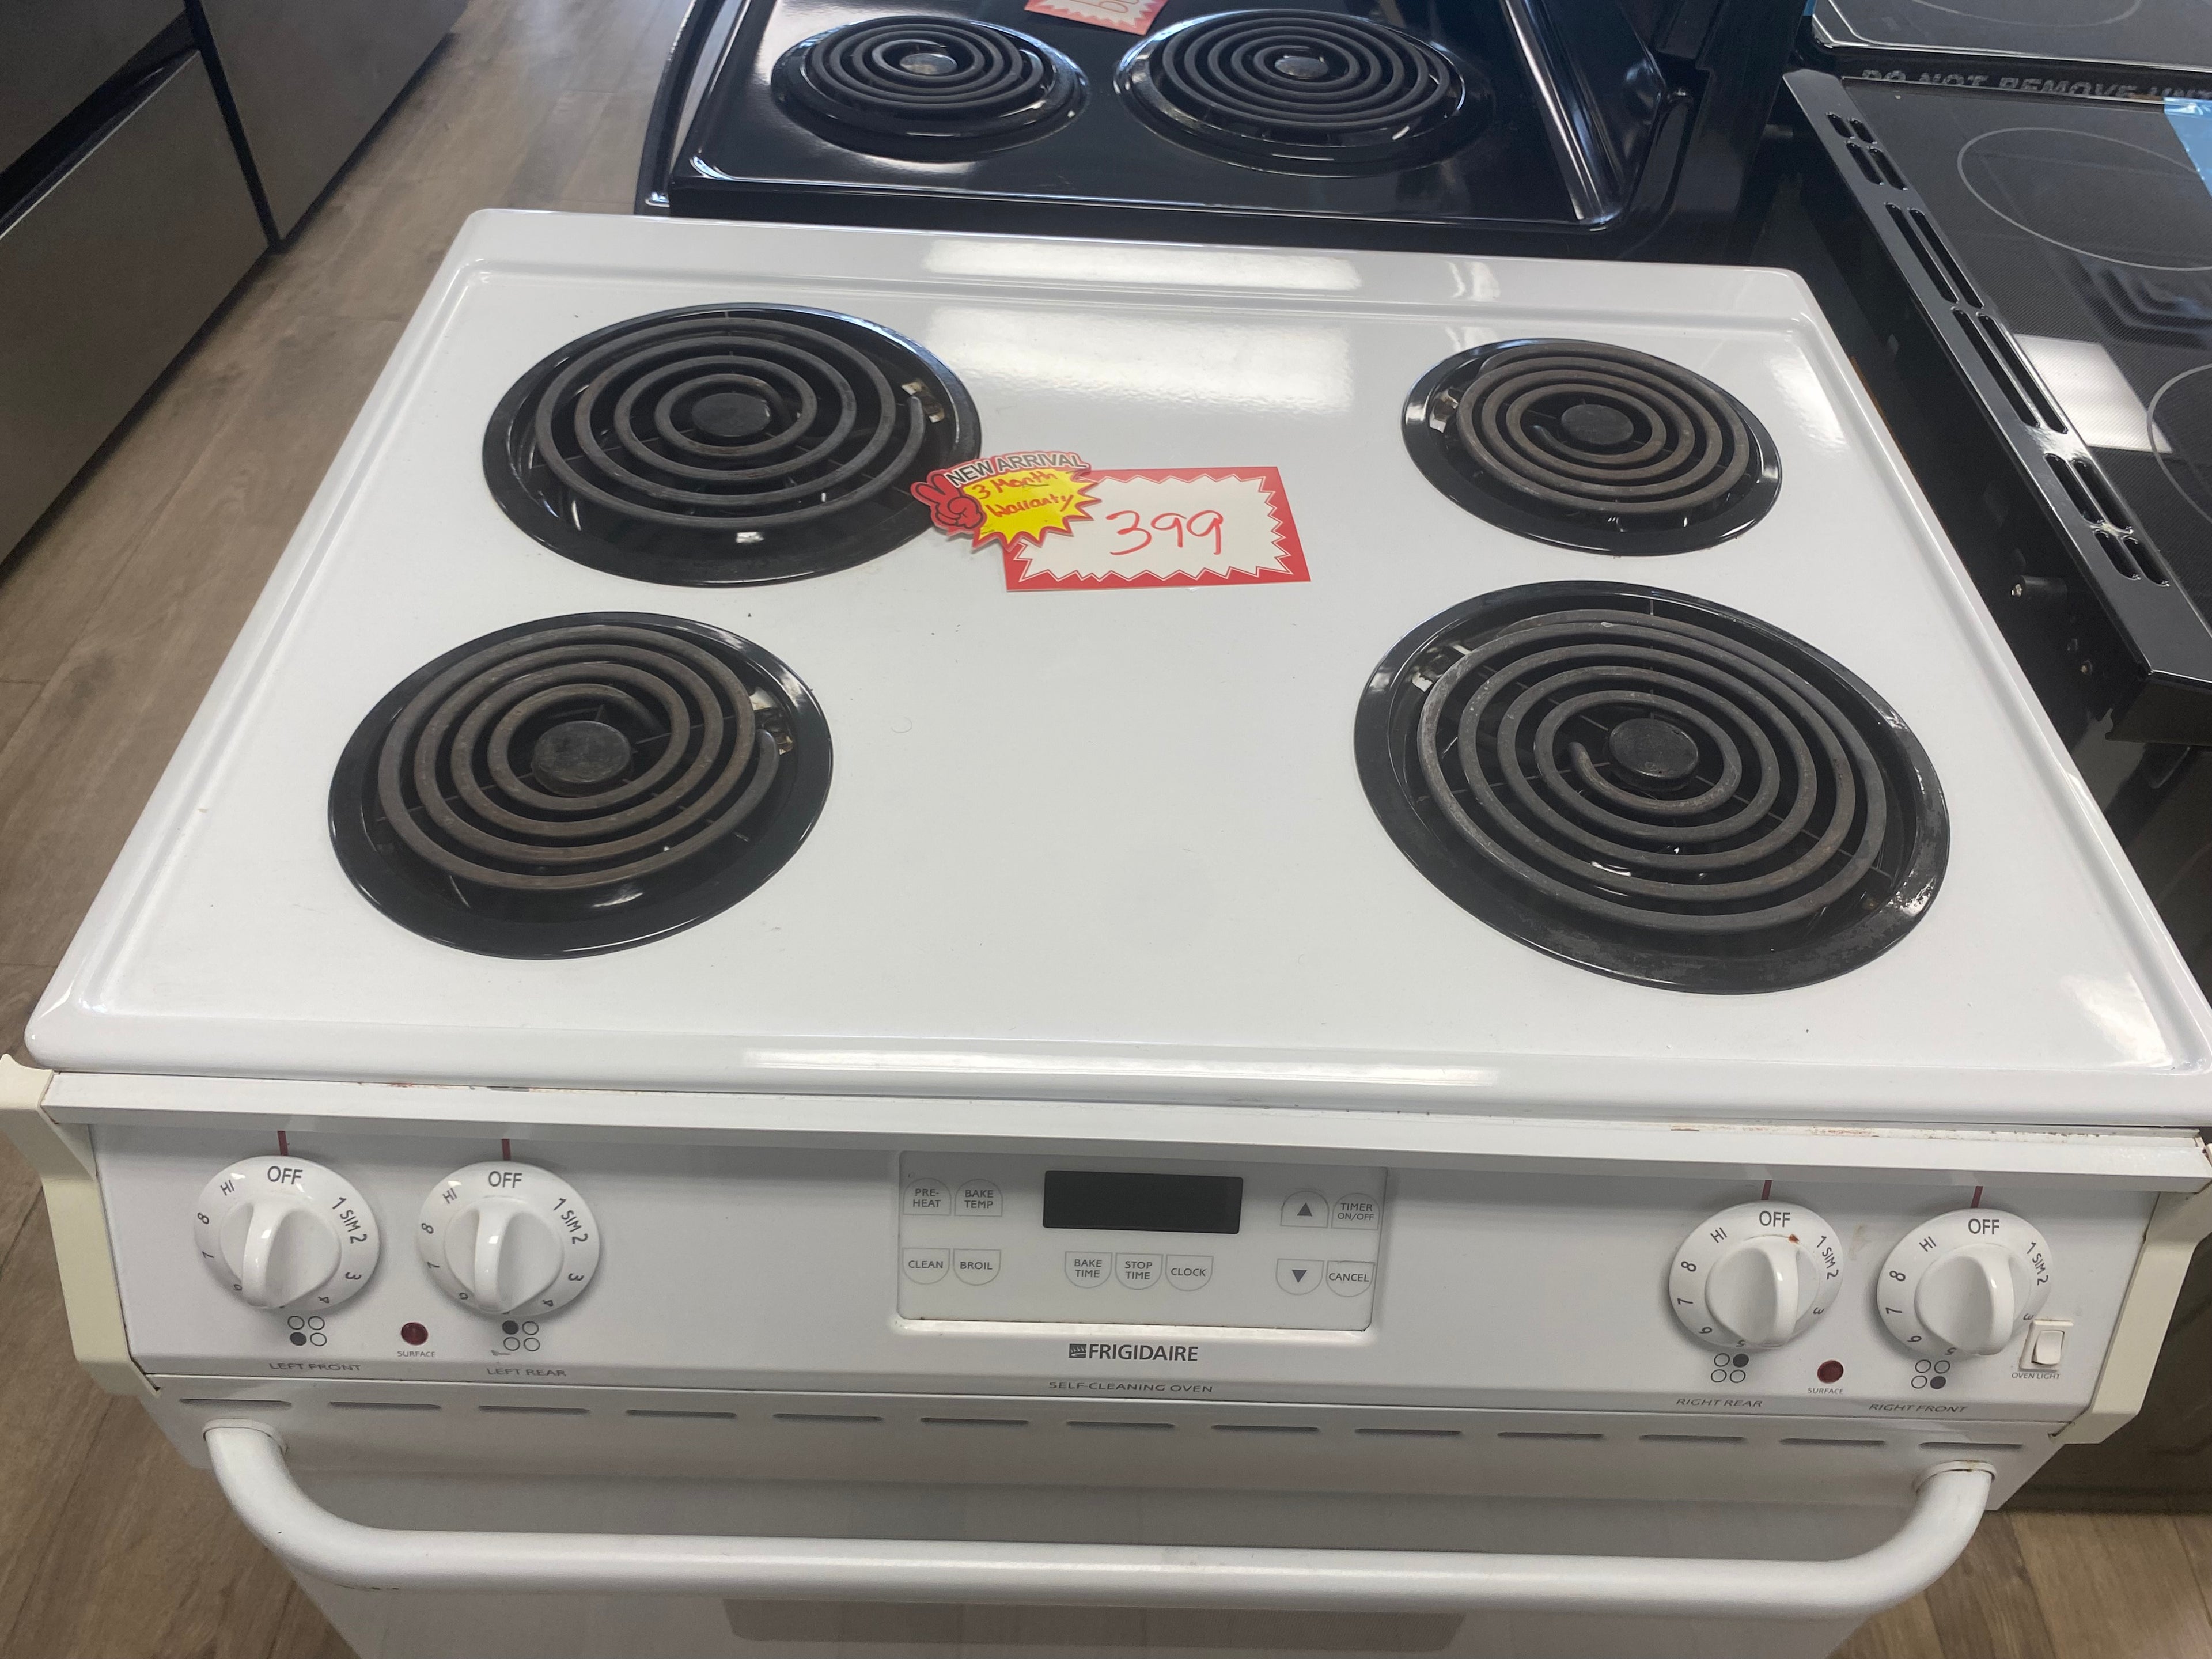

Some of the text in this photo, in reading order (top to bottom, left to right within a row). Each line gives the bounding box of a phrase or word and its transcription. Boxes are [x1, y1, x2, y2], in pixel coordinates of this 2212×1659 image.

[945, 454, 1088, 486] NEW ARRIVAL
[972, 484, 991, 499] 3
[1105, 510, 1224, 555] 399
[267, 1165, 303, 1184] OFF
[488, 1171, 522, 1188] OFF
[220, 1180, 235, 1196] HI
[915, 1188, 940, 1197] PRE-
[442, 1188, 457, 1204] HI
[964, 1190, 994, 1198] BAKE
[912, 1199, 941, 1208] HEAT
[964, 1200, 994, 1209] TEMP
[1340, 1203, 1373, 1212] TIMER
[197, 1212, 210, 1225] 8
[332, 1196, 368, 1244] 1 SIM 2
[553, 1198, 588, 1244] 1 SIM 2
[1337, 1213, 1374, 1221] ON/OFF
[1759, 1210, 1791, 1228] OFF
[421, 1222, 434, 1234] 8
[1968, 1218, 2000, 1235] OFF
[1710, 1227, 1728, 1244] HI
[1919, 1236, 1937, 1252] HI
[1074, 1259, 1103, 1267] BAKE
[1816, 1236, 1839, 1280] 1 SIM 2
[908, 1260, 944, 1269] CLEAN
[960, 1262, 993, 1270] BROIL
[1124, 1261, 1153, 1270] STOP
[1680, 1261, 1697, 1272] 8
[2027, 1241, 2048, 1286] 1 SIM 2
[345, 1272, 362, 1280] 3
[568, 1273, 584, 1282] 3
[1075, 1270, 1100, 1278] TIME
[1126, 1271, 1151, 1280] TIME
[1171, 1268, 1207, 1277] CLOCK
[1328, 1273, 1369, 1282] CANCEL
[1889, 1270, 1906, 1282] 8
[1885, 1307, 1903, 1315] 7
[1089, 1343, 1199, 1361] FRIGIDAIRE
[269, 1362, 361, 1371] LEFT FRONT
[487, 1368, 566, 1377] LEFT REAR
[1048, 1381, 1213, 1392] SELF-CLEANING OVEN
[1676, 1398, 1763, 1407] RIGHT REAR
[1869, 1403, 1968, 1413] RIGHT FRONT
